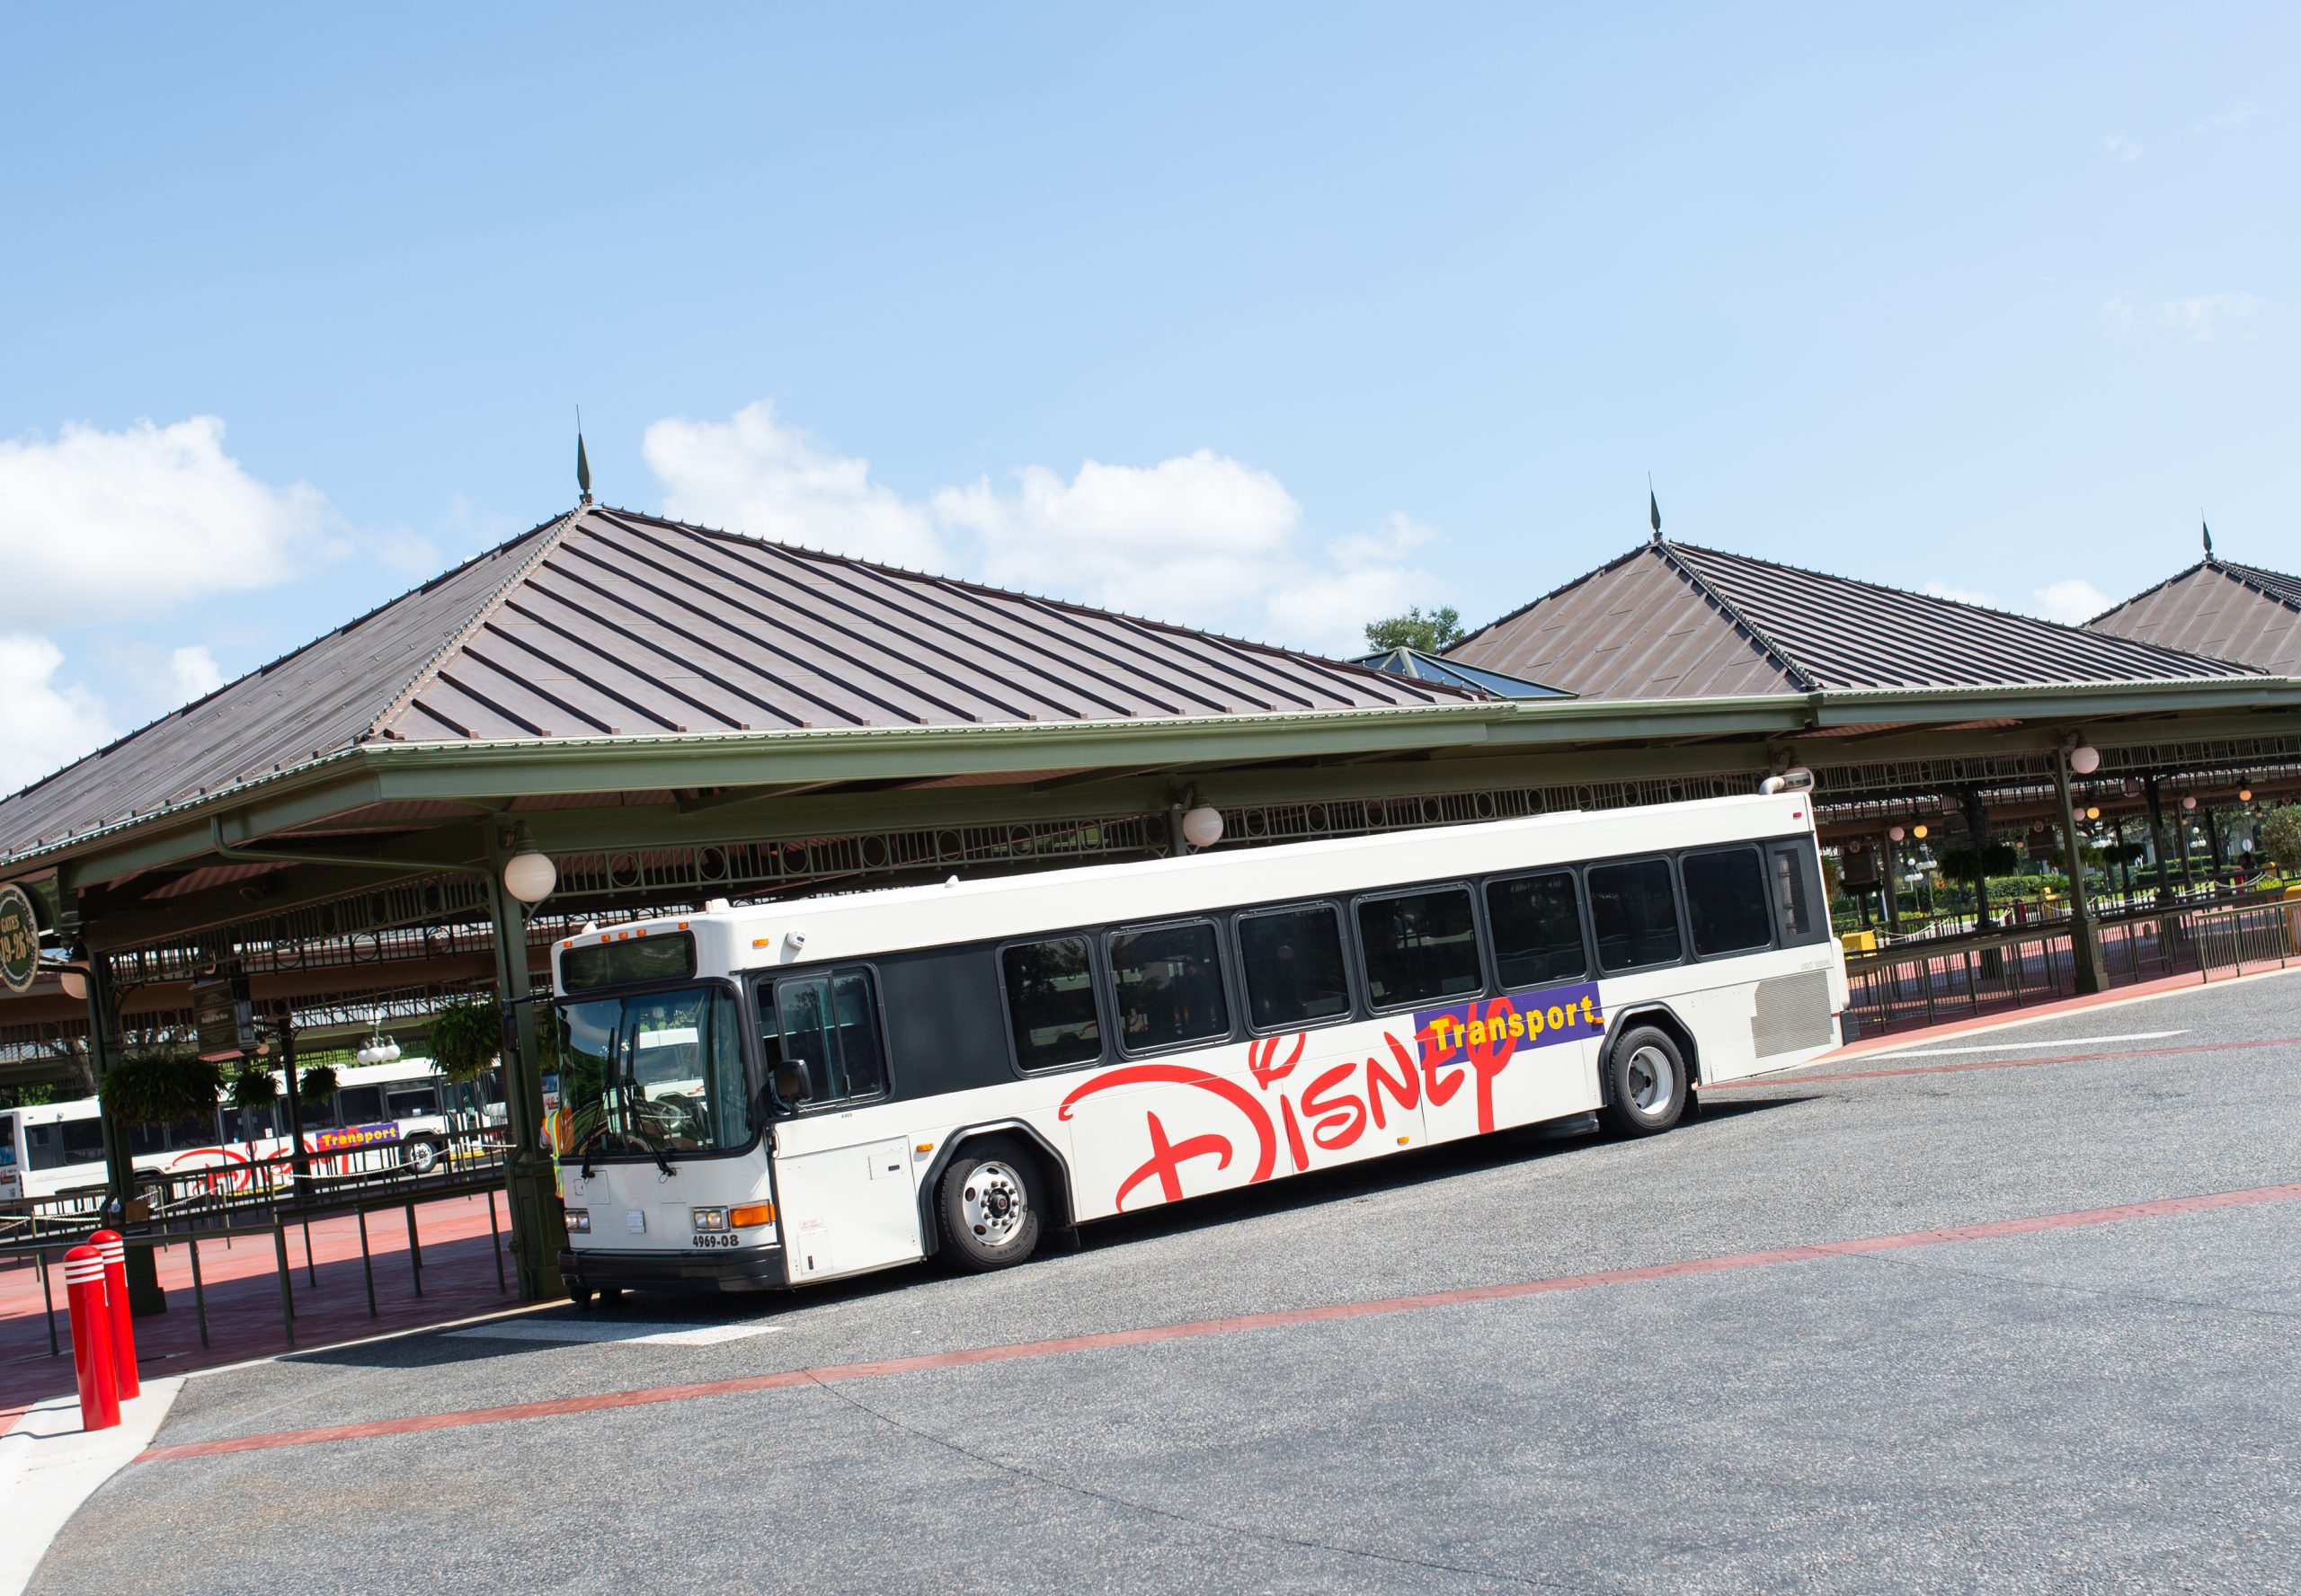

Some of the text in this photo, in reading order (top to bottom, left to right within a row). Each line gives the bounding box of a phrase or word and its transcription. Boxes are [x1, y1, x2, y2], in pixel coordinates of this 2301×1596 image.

[1, 914, 20, 933] GATES
[0, 932, 27, 963] 19-26
[1429, 995, 1595, 1051] Transport
[322, 1127, 396, 1147] Transport
[692, 1234, 739, 1247] 4969-08
